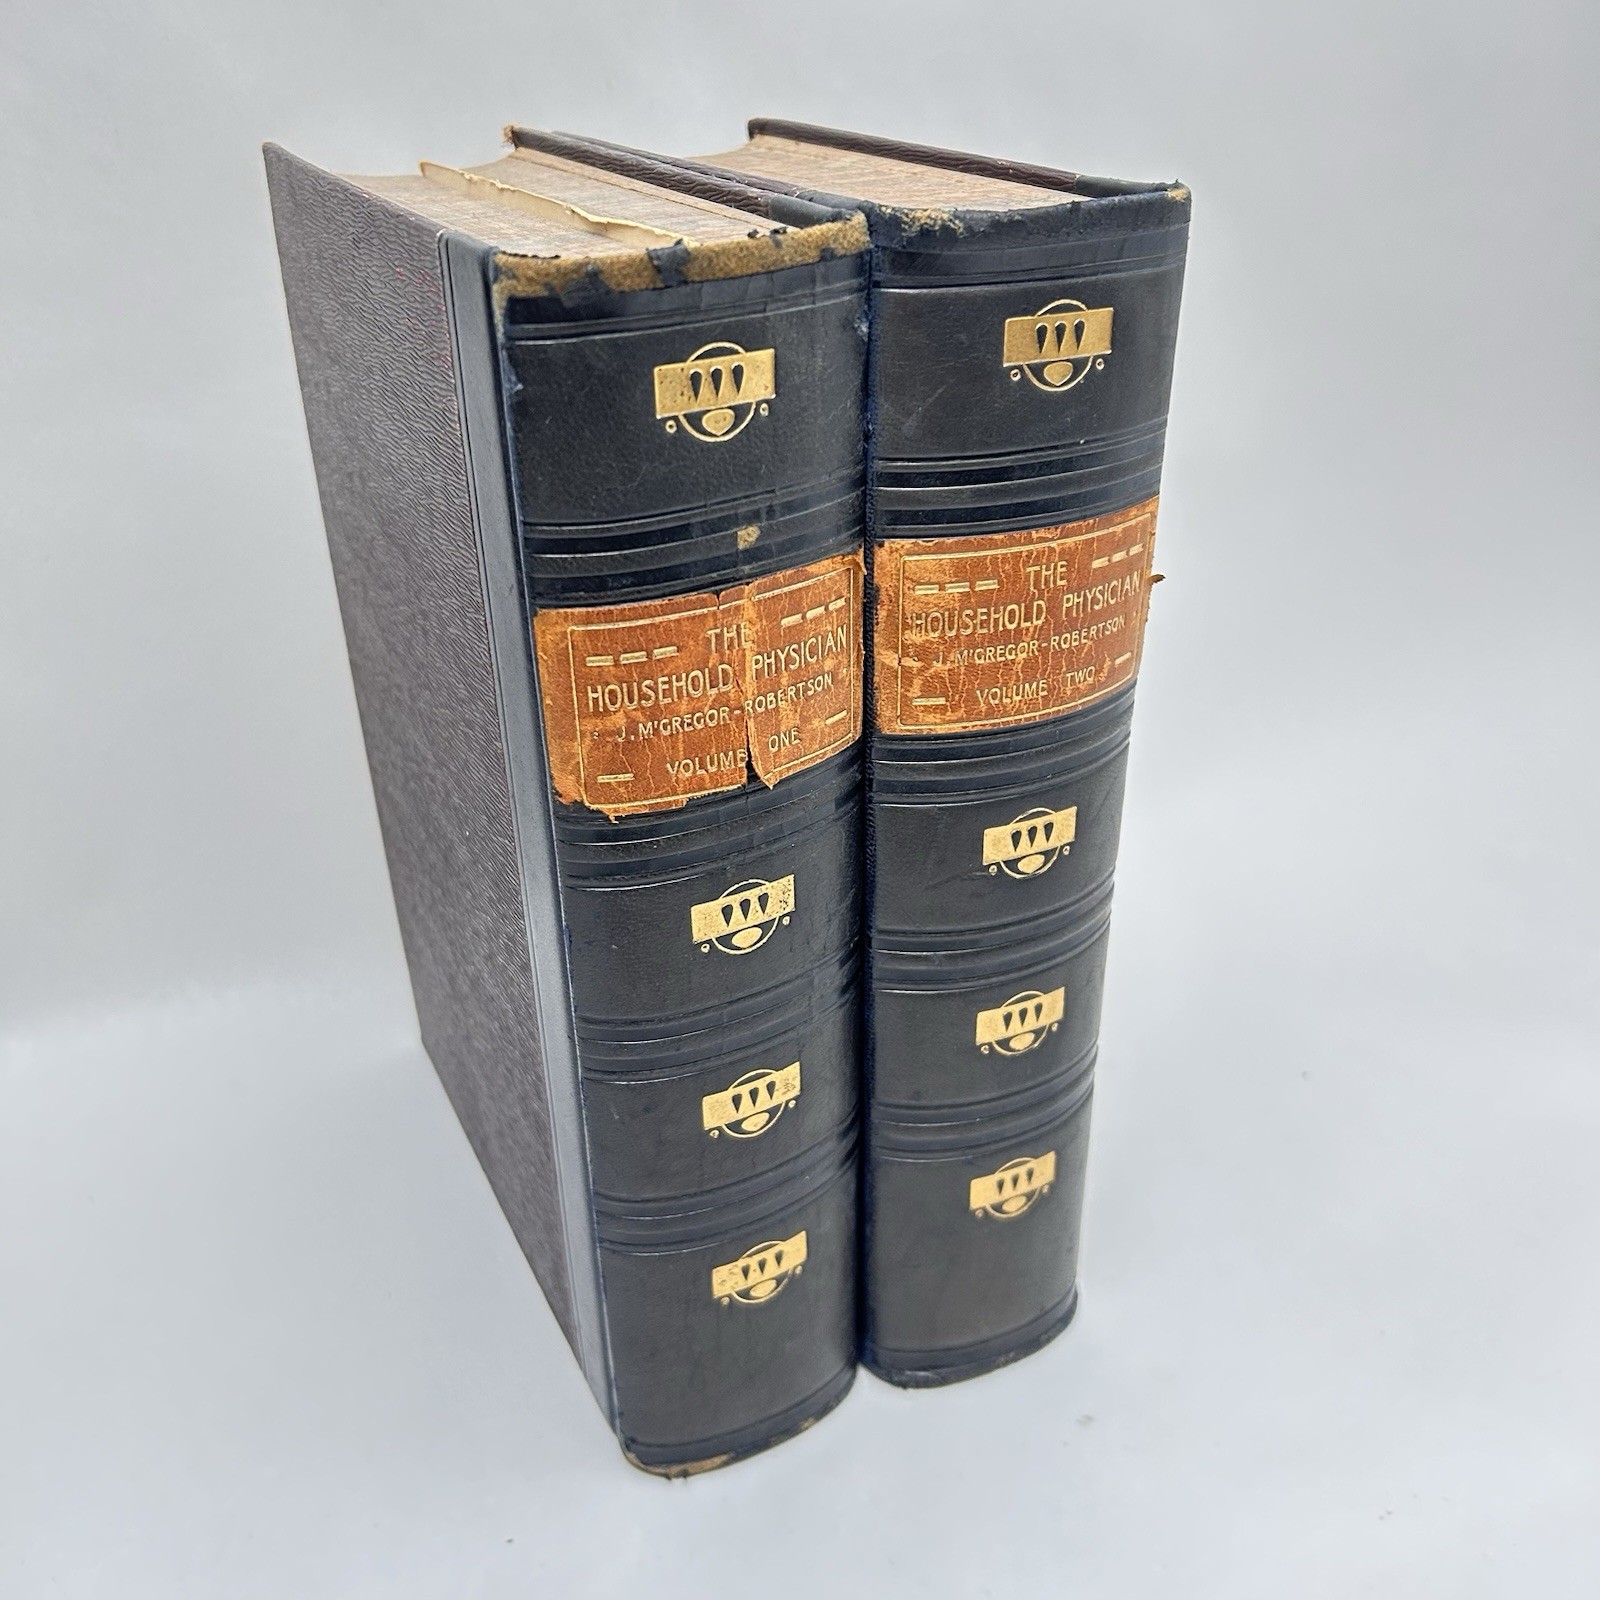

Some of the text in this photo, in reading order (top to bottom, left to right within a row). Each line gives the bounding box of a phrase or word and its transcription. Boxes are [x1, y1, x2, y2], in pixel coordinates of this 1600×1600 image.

[1026, 560, 1068, 590] THE
[911, 570, 1141, 638] HOUSEHOLD PHYSICIAN
[706, 621, 754, 653] THE
[587, 624, 847, 712] HOUSEHOLD PHYSICIAN
[976, 666, 1096, 708] VOLUME TWO
[666, 727, 801, 777] VOLUME ONE
